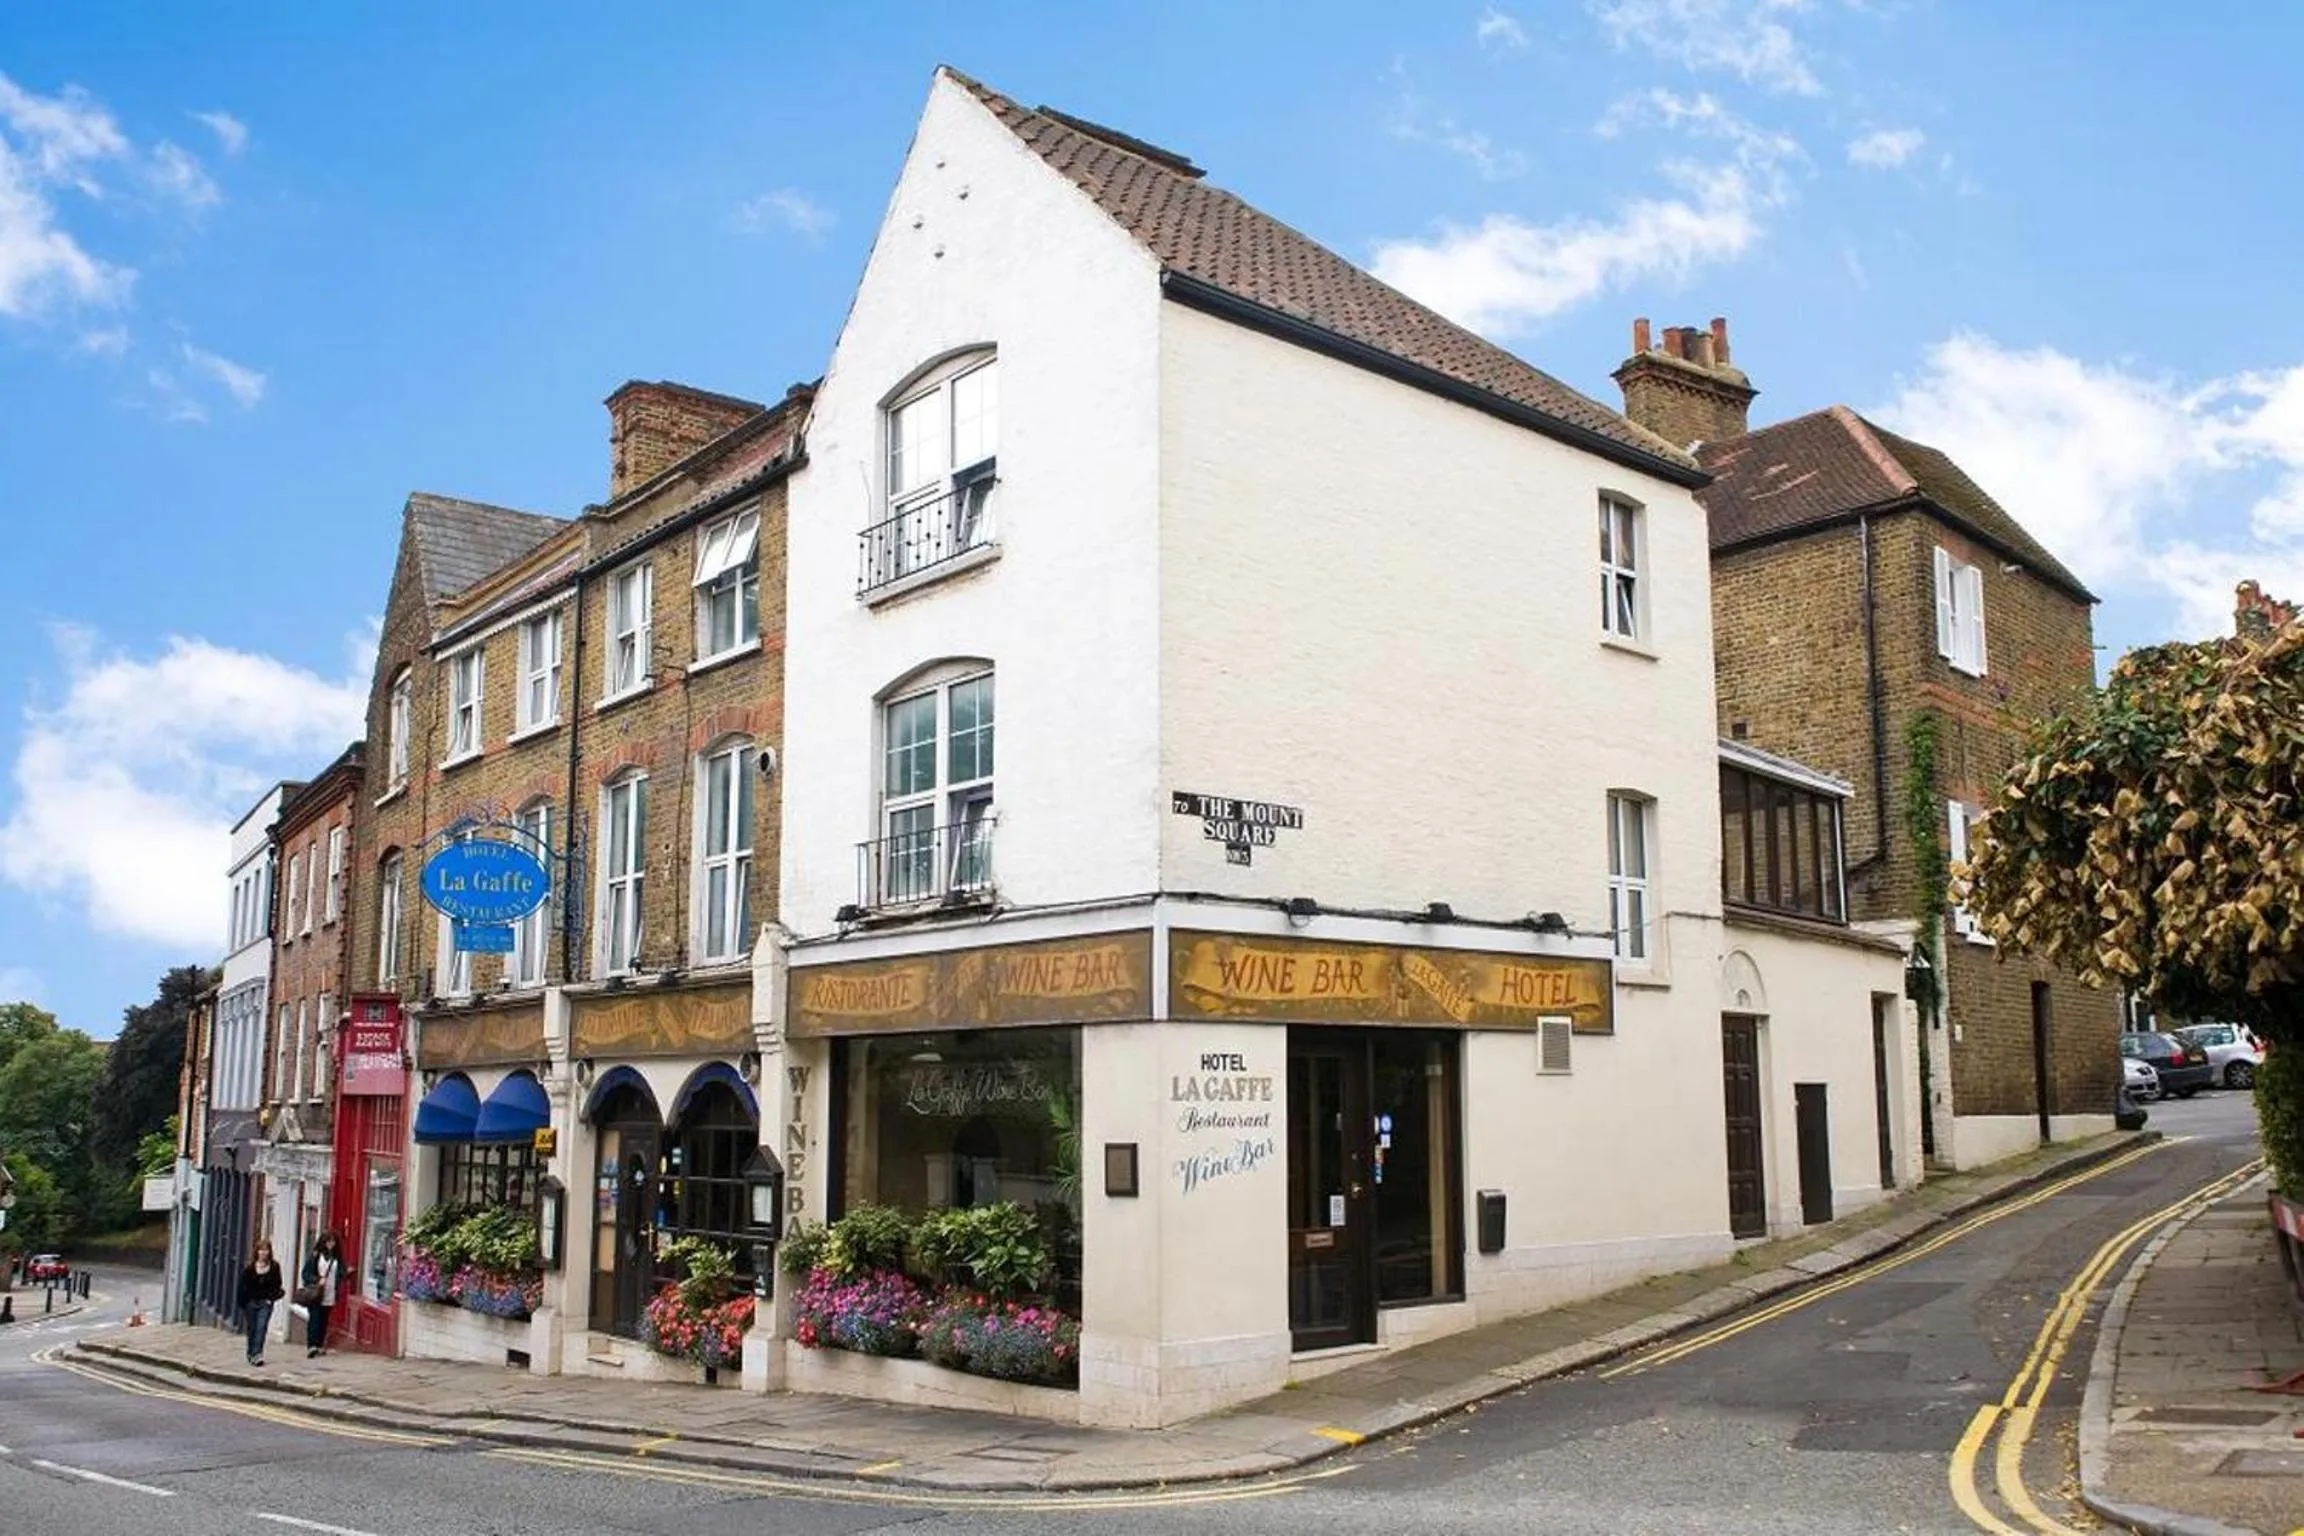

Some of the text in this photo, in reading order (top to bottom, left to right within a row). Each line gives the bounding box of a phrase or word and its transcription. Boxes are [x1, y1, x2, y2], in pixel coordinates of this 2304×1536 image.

[1197, 796, 1235, 819] THE
[1240, 801, 1301, 828] MOUNT
[1203, 820, 1276, 845] SQUARE
[440, 868, 533, 893] La Gaffe
[1003, 955, 1065, 994] WINE
[1070, 950, 1126, 990] BAR
[1217, 954, 1368, 995] WINE BAR
[1500, 966, 1578, 1006] HOTEL
[811, 968, 913, 1011] RISTORANTE
[1200, 1053, 1248, 1071] HOTEL
[1170, 1076, 1201, 1101] LA
[1178, 1106, 1270, 1132] Restaurant
[1172, 1138, 1274, 1196] Wine Bar
